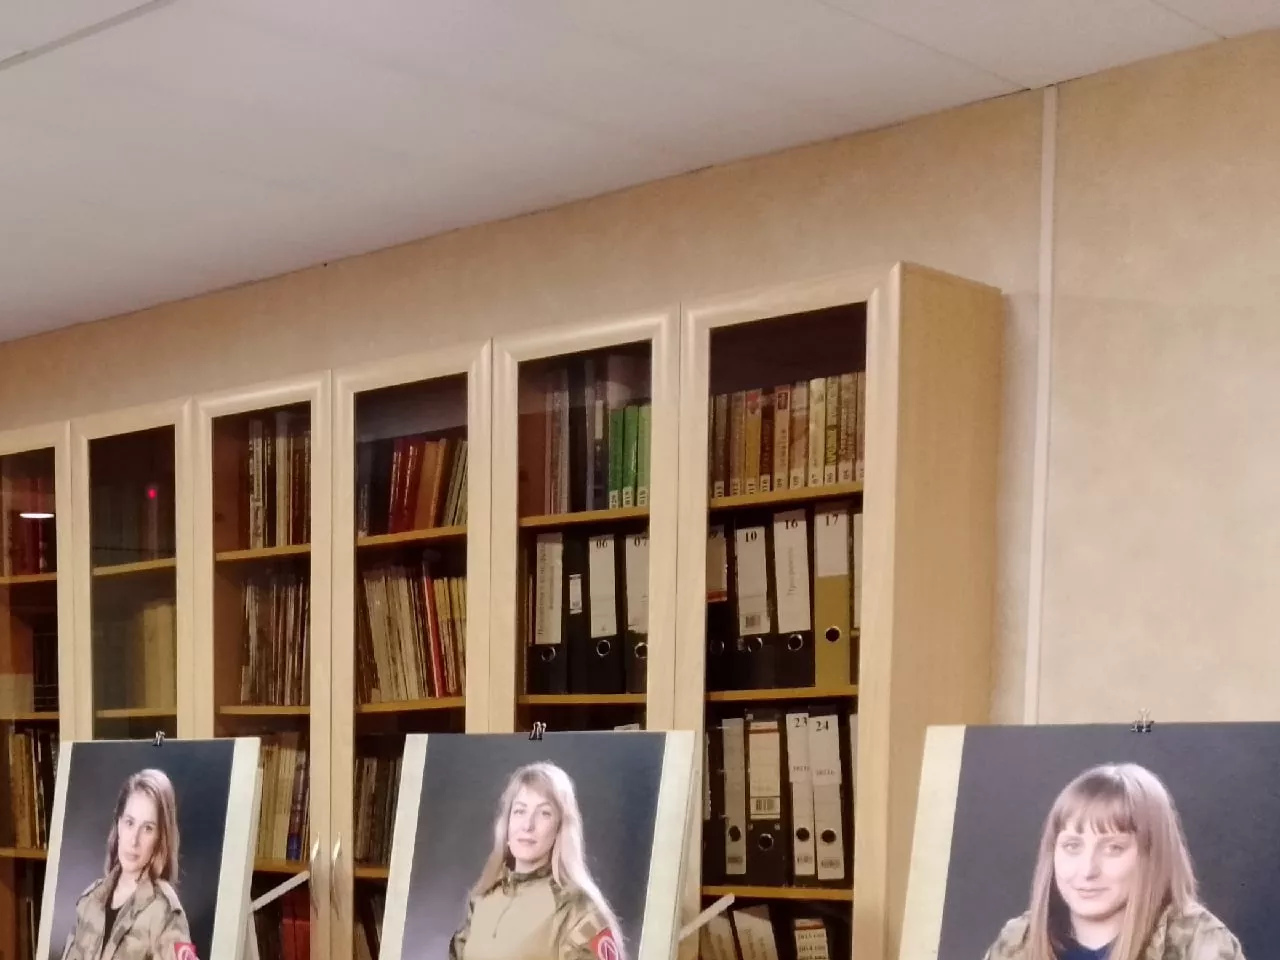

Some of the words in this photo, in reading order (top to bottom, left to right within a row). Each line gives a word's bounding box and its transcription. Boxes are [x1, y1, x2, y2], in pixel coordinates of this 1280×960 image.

[784, 518, 798, 530] 16
[825, 514, 839, 527] 17
[634, 536, 649, 548] 07
[745, 530, 758, 543] 10
[596, 540, 609, 550] 06
[794, 716, 808, 729] 23
[815, 720, 830, 732] 24
